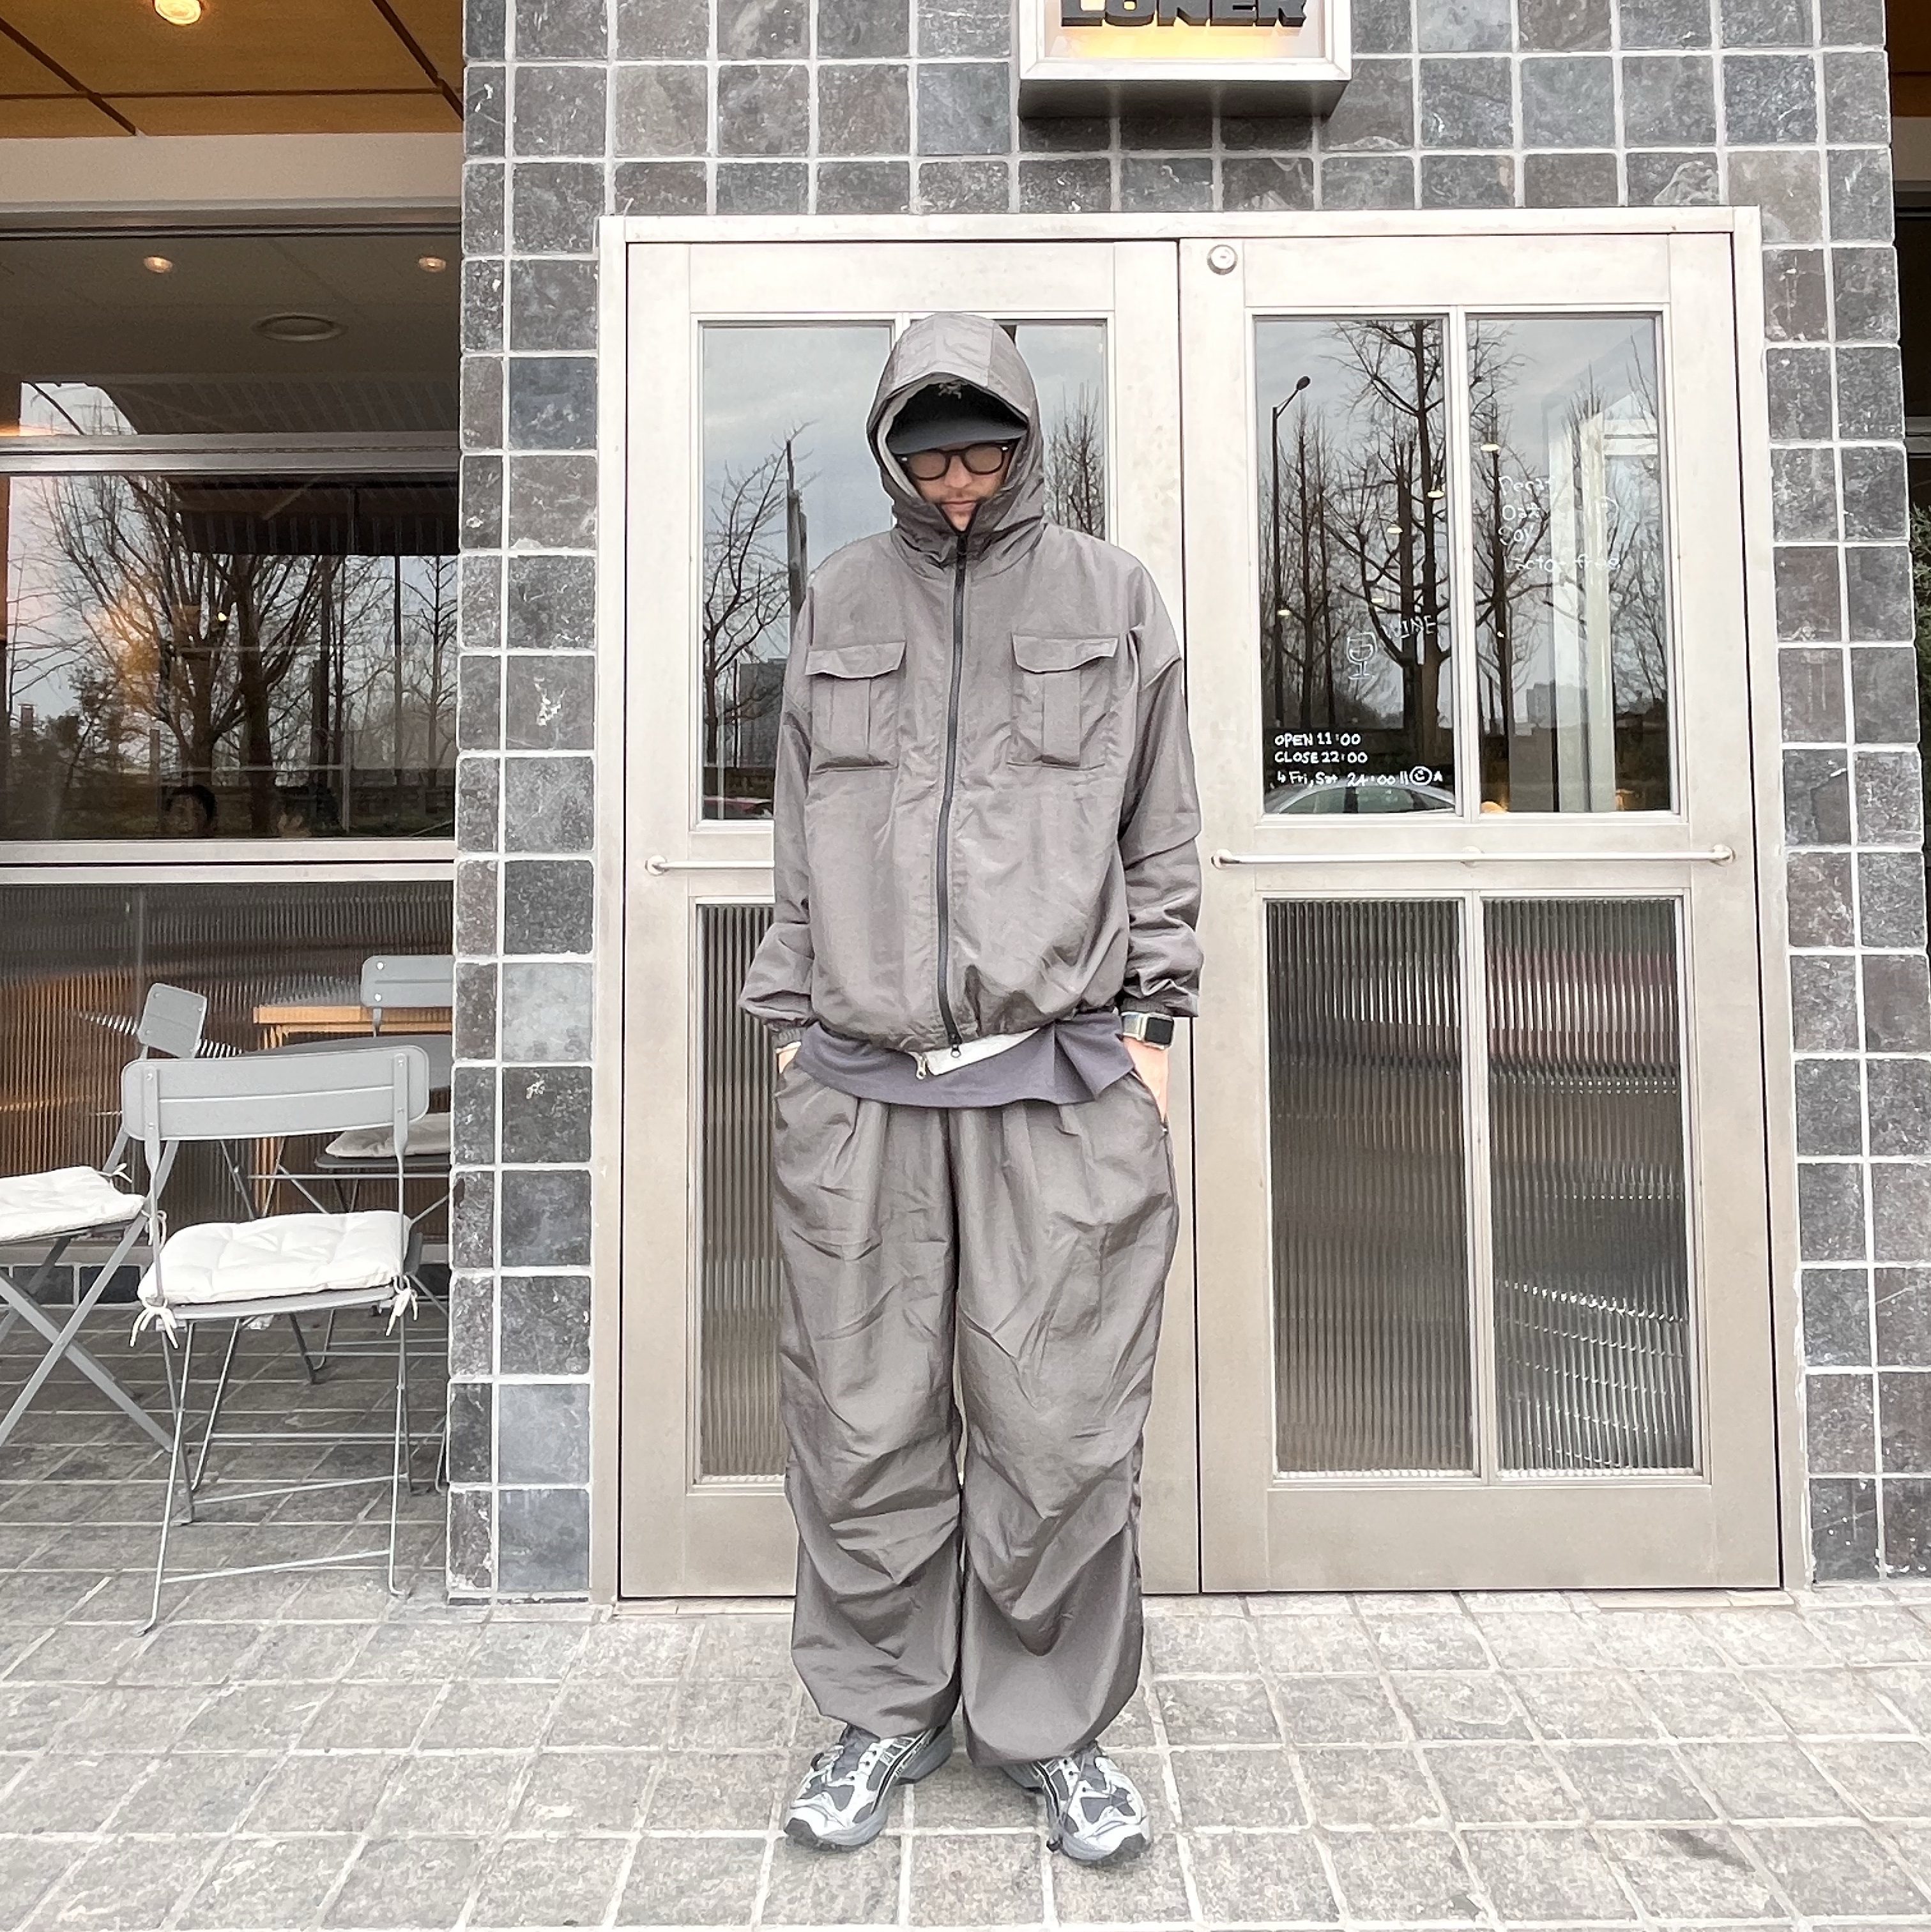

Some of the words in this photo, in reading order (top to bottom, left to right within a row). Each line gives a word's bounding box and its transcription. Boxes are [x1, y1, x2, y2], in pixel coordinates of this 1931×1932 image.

[1380, 614, 1437, 639] WINE
[1274, 733, 1314, 747] OPEN
[1317, 732, 1361, 747] 11:00
[1274, 750, 1320, 764] CLOSE
[1321, 750, 1368, 764] 22:00
